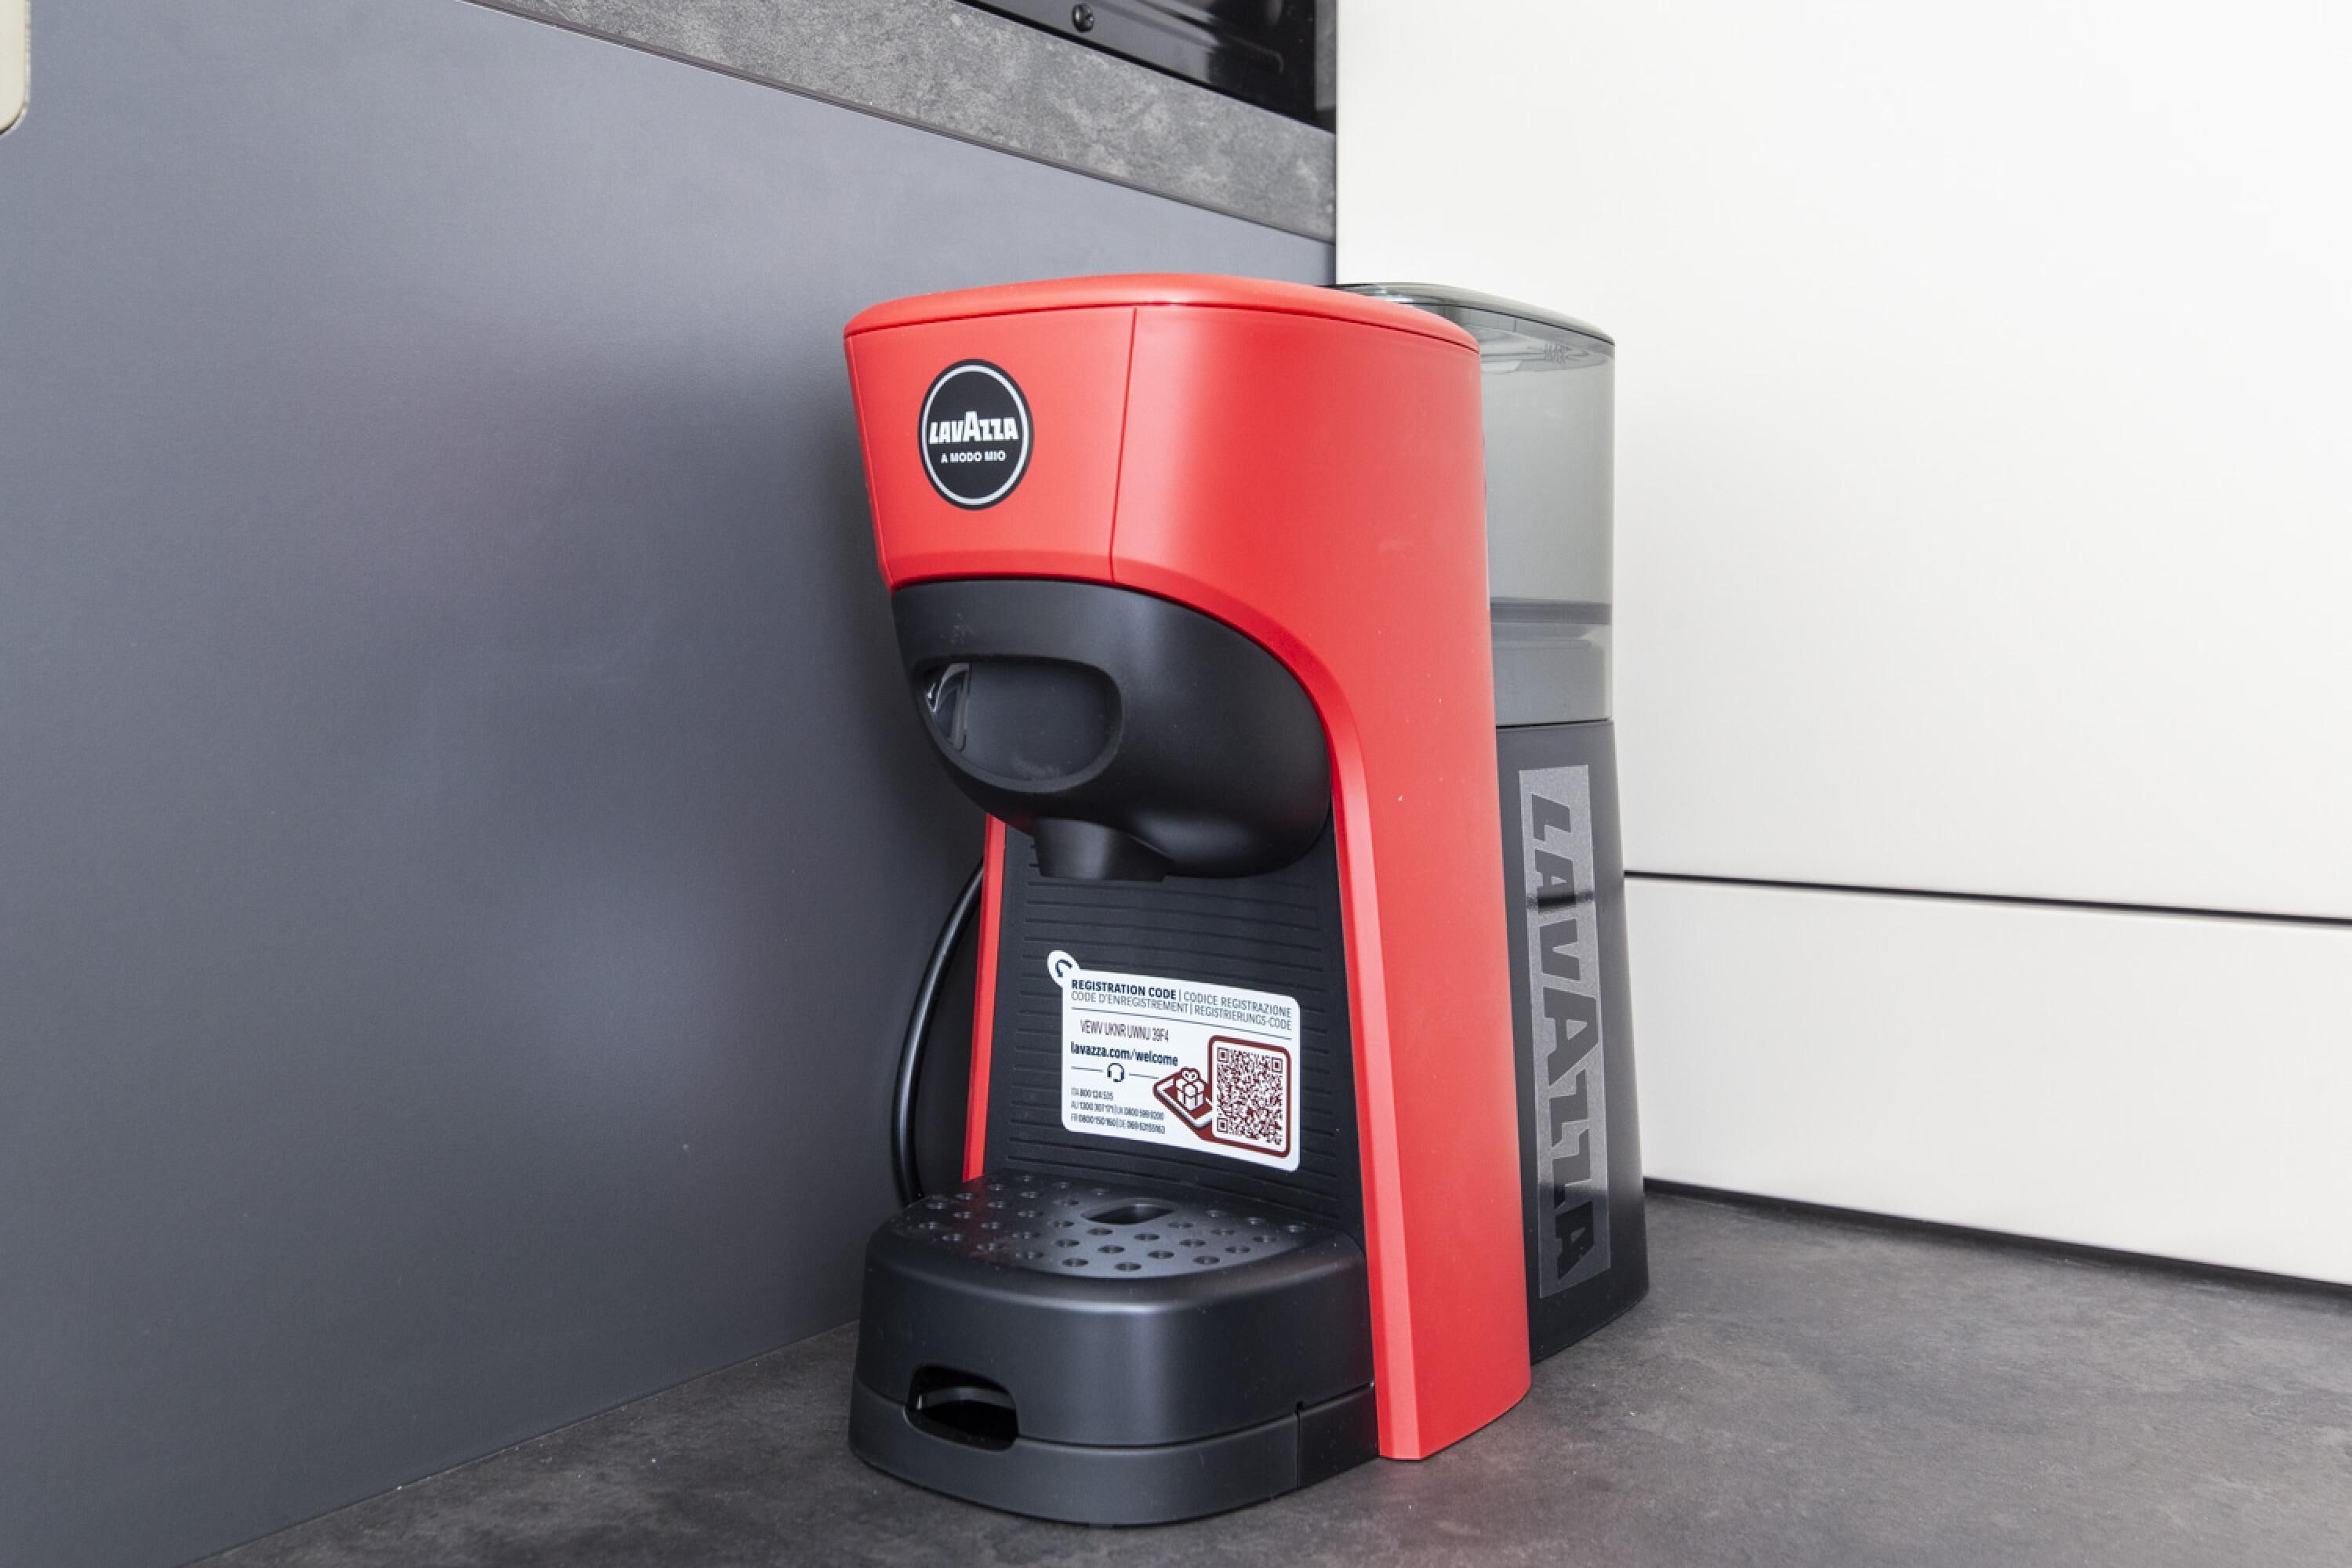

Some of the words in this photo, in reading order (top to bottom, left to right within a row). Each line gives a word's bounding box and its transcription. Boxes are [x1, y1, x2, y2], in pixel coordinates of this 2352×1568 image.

[929, 410, 1019, 445] LAVAZZA
[941, 452, 948, 463] A
[950, 452, 982, 463] MODO
[985, 450, 1007, 461] MIO
[1071, 979, 1145, 996] REGISTRATION
[1149, 987, 1177, 1000] CODE
[1183, 991, 1218, 1006] CODICE
[1221, 996, 1292, 1018] REGISTRAZIONE
[1071, 991, 1096, 1003] CODE
[1098, 993, 1189, 1014] D'ENREGISTREMENT
[1194, 1004, 1292, 1031] REGISTRIERUNGS-CODE
[1071, 1041, 1178, 1066] lavazza.com/welcome
[1531, 793, 1599, 1281] LAVAZZA
